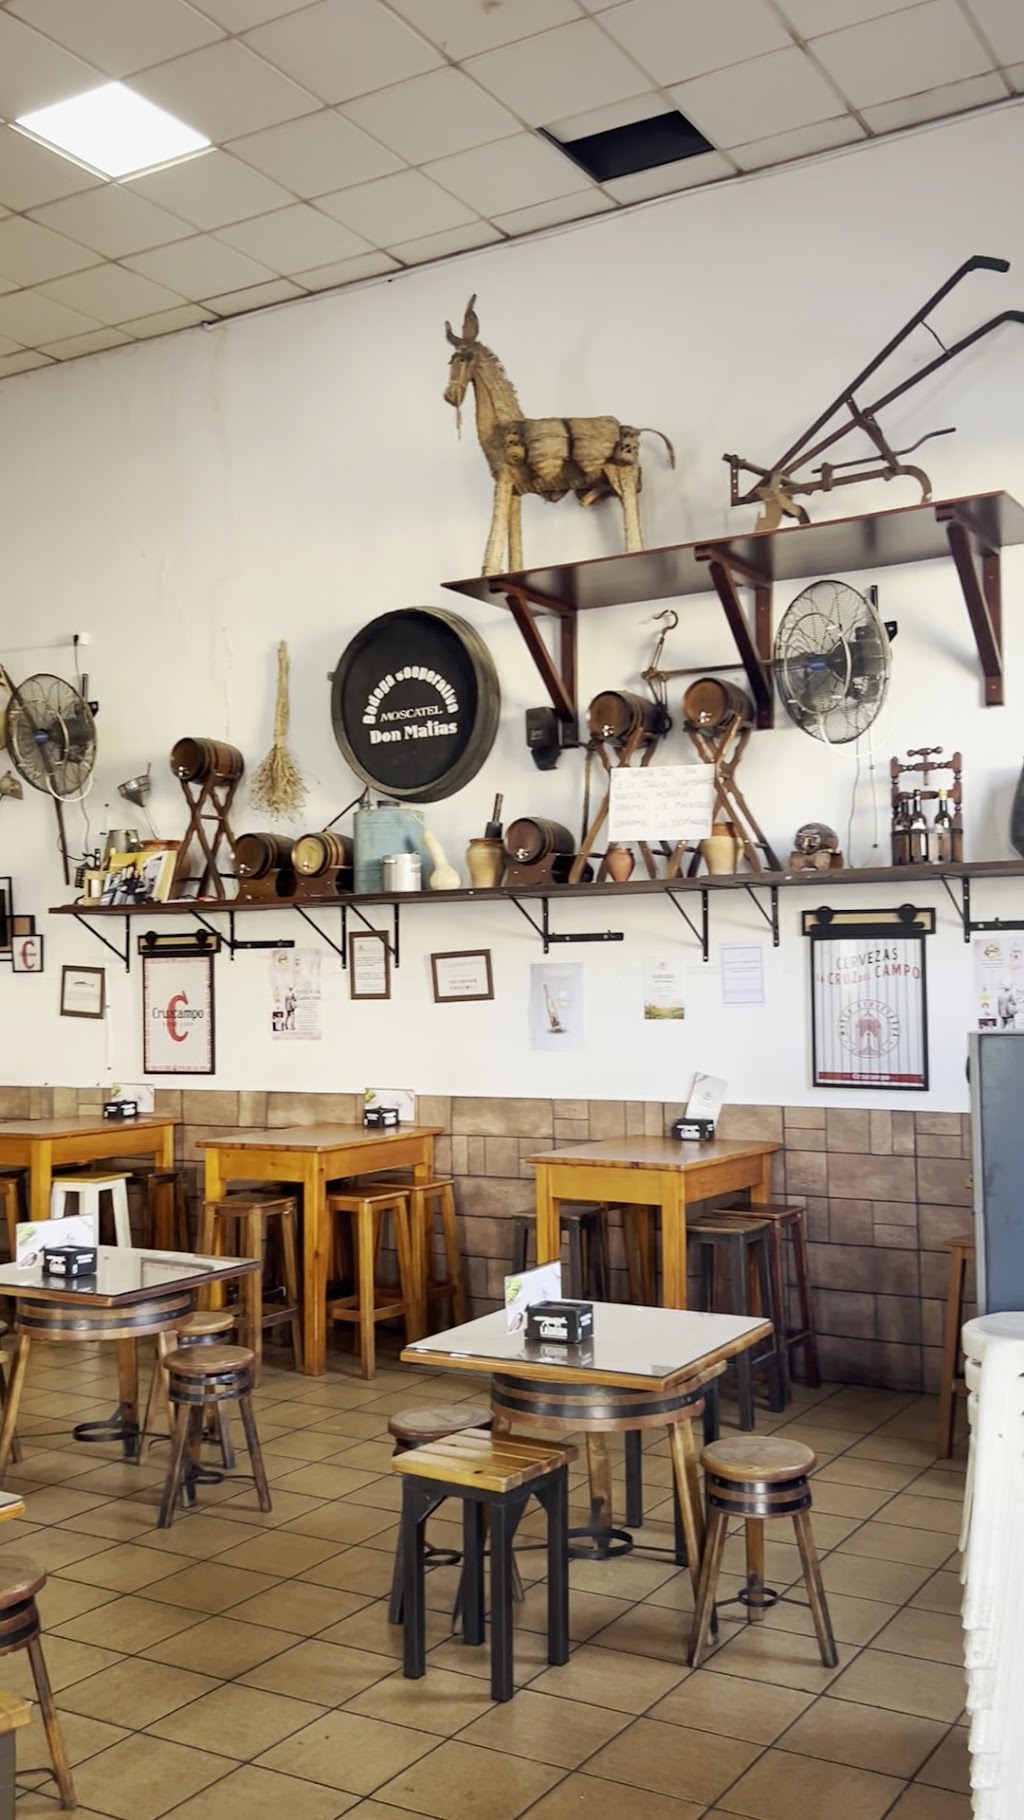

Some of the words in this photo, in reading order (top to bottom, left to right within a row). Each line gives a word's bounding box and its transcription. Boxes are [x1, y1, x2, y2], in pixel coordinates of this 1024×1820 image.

[380, 705, 444, 722] MOSCATEL
[369, 730, 402, 744] Don
[404, 720, 458, 739] Matias
[836, 948, 898, 970] CERVEZAS
[828, 971, 857, 985] CRUZ
[875, 963, 921, 979] CAMPO
